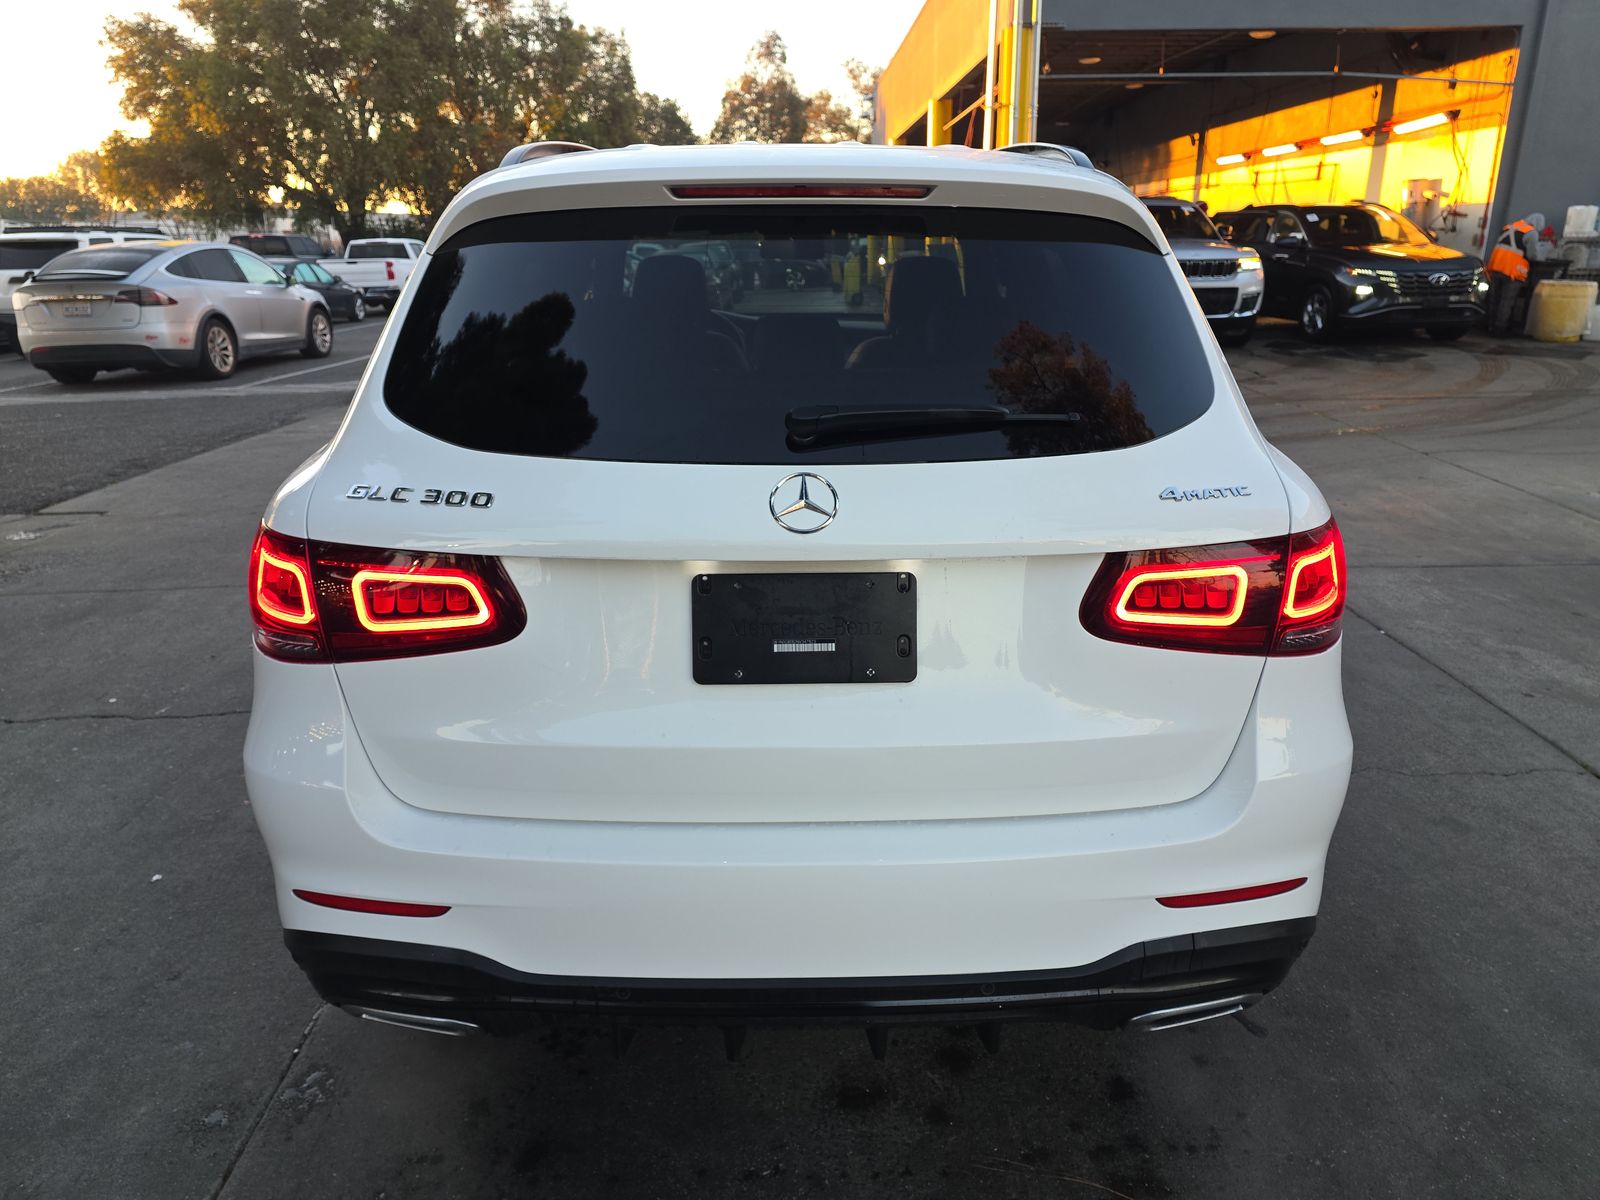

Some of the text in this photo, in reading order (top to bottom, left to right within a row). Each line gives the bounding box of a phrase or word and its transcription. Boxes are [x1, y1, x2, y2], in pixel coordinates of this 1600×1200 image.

[345, 484, 495, 508] GLC 300
[1158, 485, 1252, 502] 4MATIC
